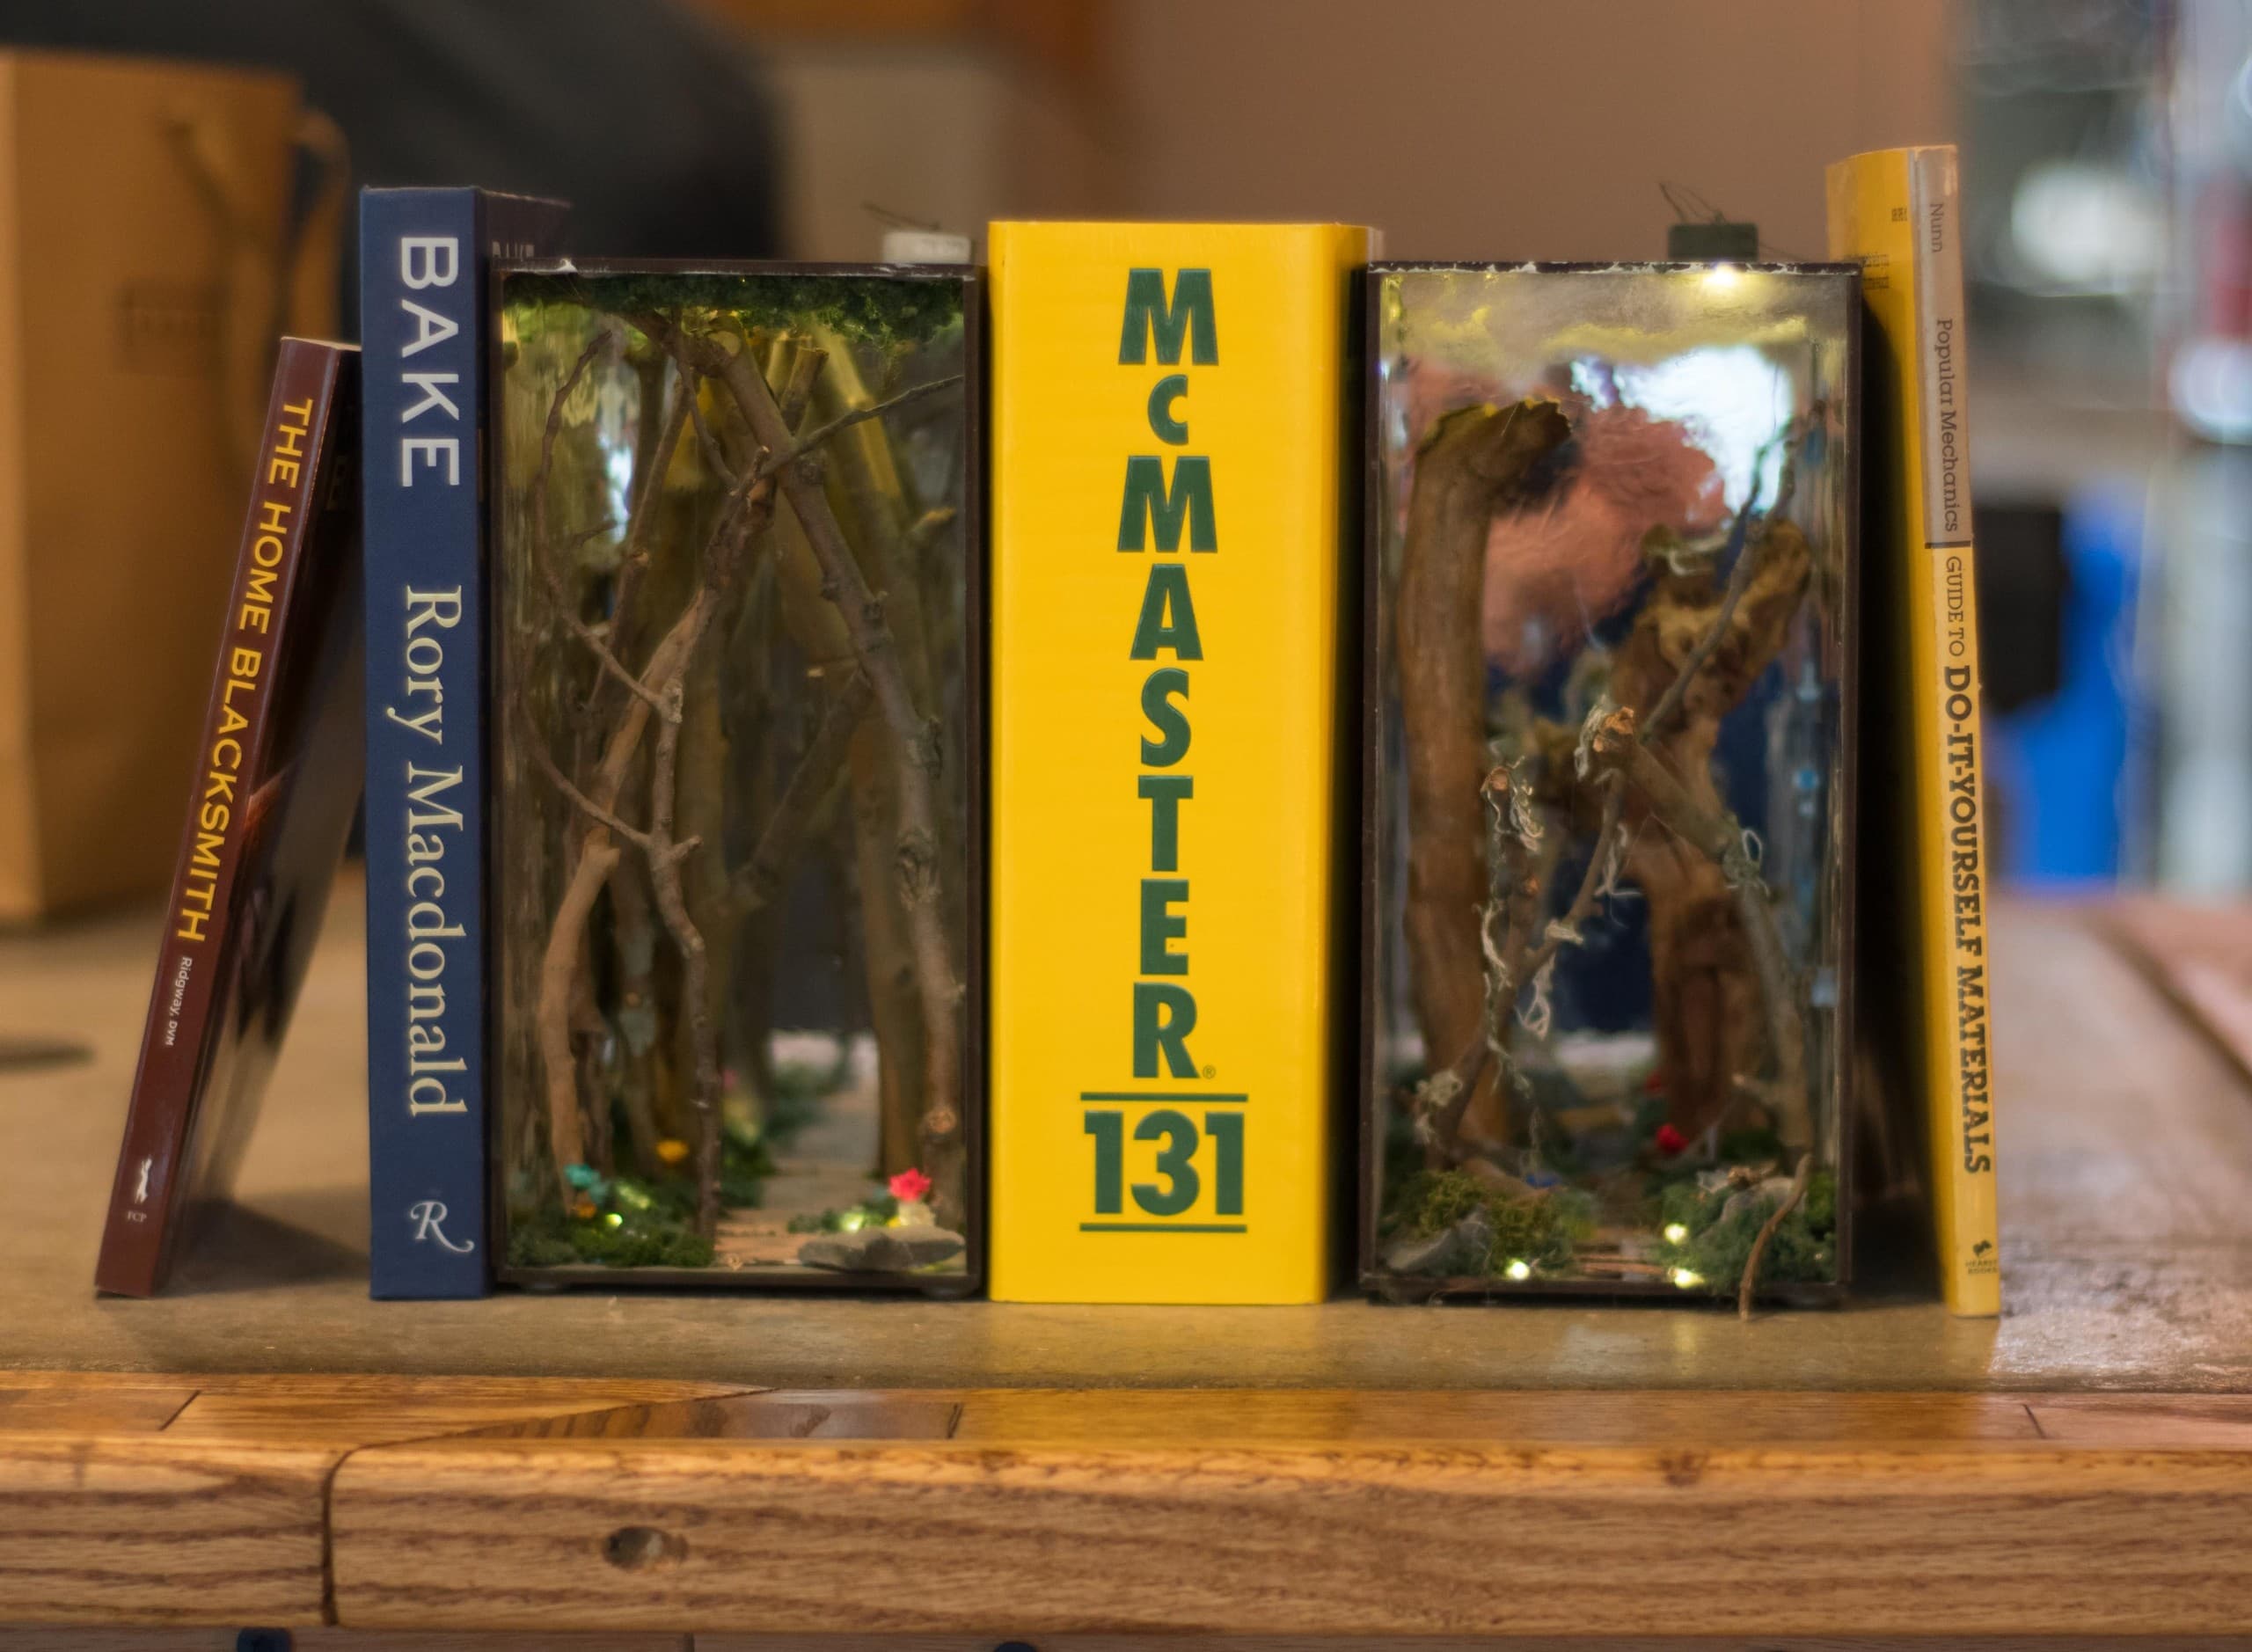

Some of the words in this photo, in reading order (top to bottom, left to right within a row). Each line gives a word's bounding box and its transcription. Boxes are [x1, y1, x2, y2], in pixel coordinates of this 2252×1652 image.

[401, 237, 460, 487] BAKE
[1934, 318, 1955, 406] Popular
[267, 398, 314, 489] THE
[1941, 410, 1961, 533] Mechanics
[238, 501, 292, 635] HOME
[1945, 555, 1963, 624] GUIDE
[386, 584, 463, 745] Rory
[1949, 626, 1965, 657] TO
[177, 647, 262, 943] BLACKSMITH
[1943, 664, 1983, 958] DO-IT-YOURSELF
[169, 955, 194, 1017] Ridgway,
[406, 760, 469, 1117] Macdonald
[165, 1020, 179, 1047] DVM
[1956, 964, 1992, 1174] MATERIALS
[1083, 1108, 1245, 1217] 131
